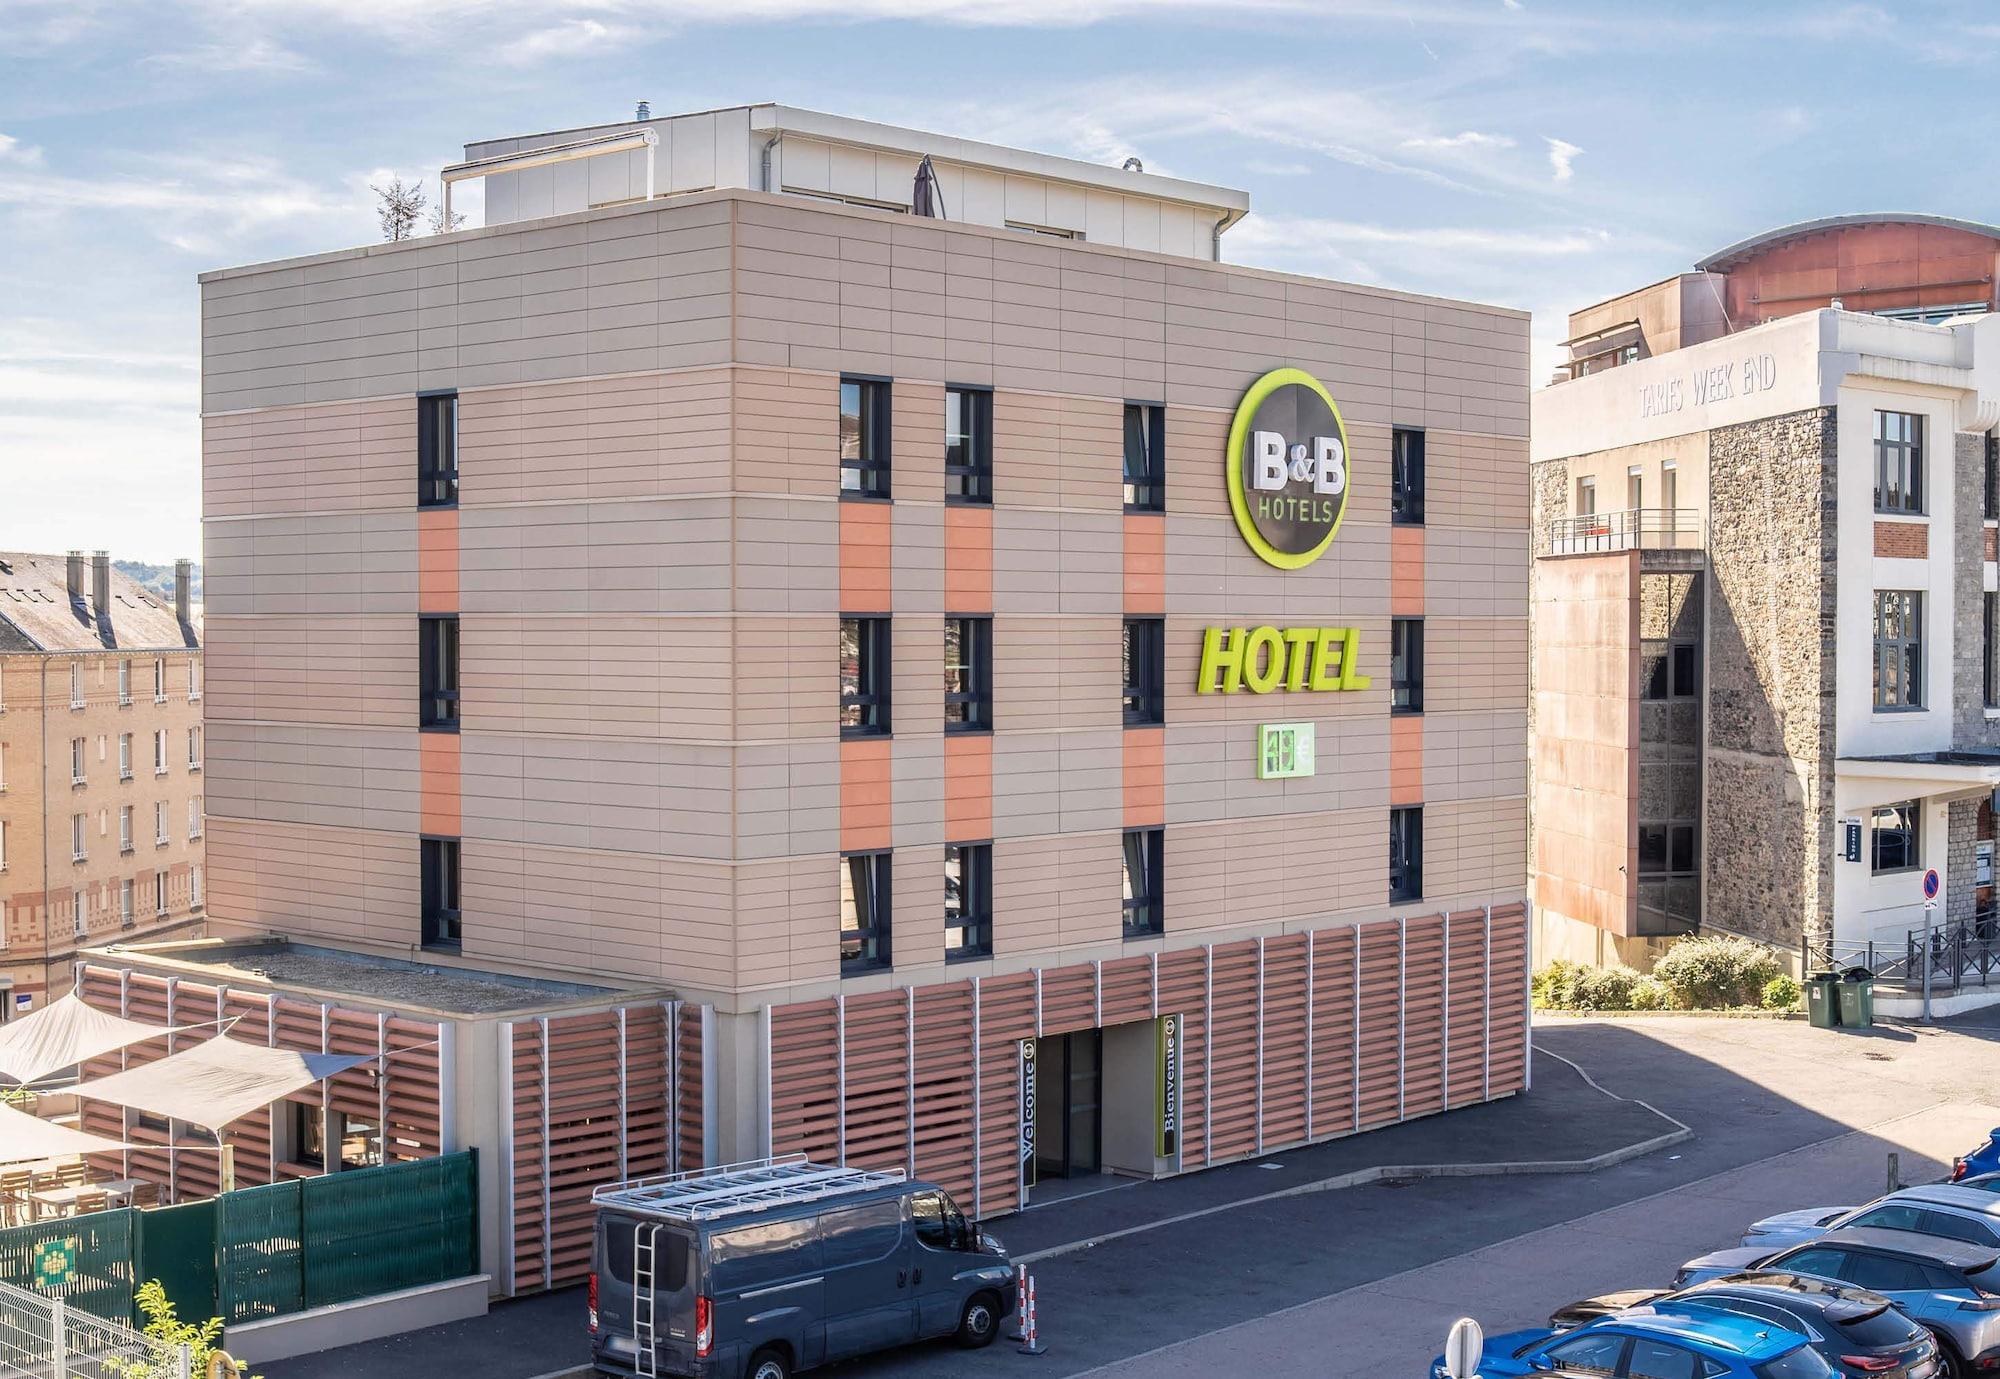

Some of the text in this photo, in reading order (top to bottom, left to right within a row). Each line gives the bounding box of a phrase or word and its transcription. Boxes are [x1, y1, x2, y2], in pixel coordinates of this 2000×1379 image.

[1639, 353, 1776, 418] TARIFS WEEK END
[1253, 431, 1346, 495] B&B
[1258, 496, 1333, 523] HOTELS
[1198, 625, 1372, 695] HOTEL
[1022, 1062, 1035, 1163] Welcome
[1164, 1037, 1175, 1133] Bienvenue
